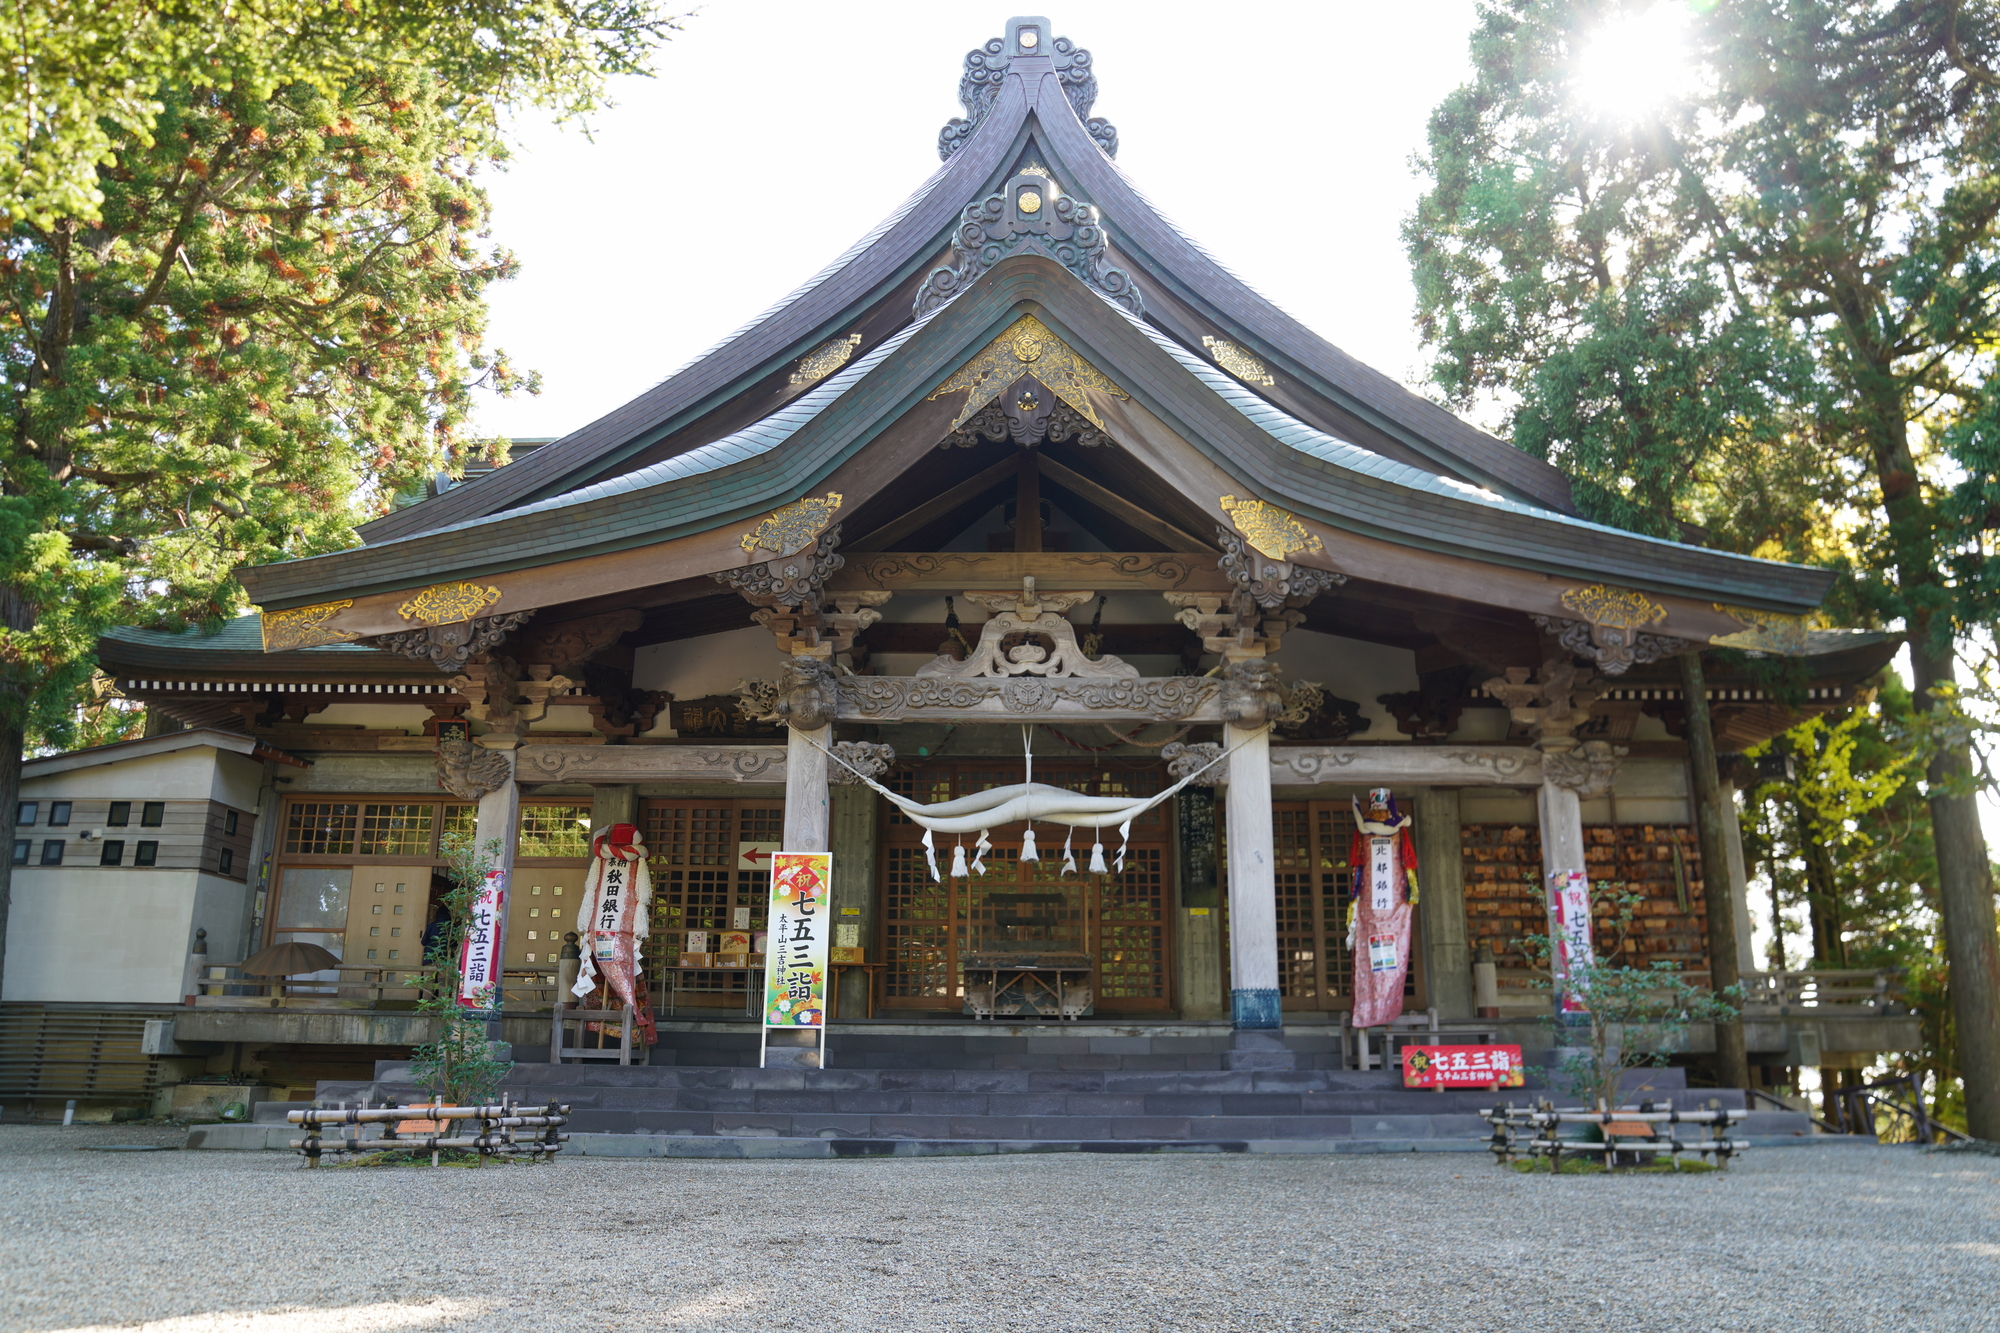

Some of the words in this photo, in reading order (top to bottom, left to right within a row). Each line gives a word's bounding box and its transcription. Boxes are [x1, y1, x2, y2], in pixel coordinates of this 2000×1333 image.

[600, 869, 622, 929] 秋田銀行
[795, 872, 813, 888] 祝
[1376, 846, 1388, 908] 北都銀行
[1568, 890, 1583, 906] 祝
[470, 909, 491, 982] 七五三詣
[776, 913, 788, 986] 太平山三吉神社
[787, 891, 816, 1001] 七五三詣
[1413, 1054, 1428, 1069] 祝
[1429, 1050, 1510, 1071] 七五三詣
